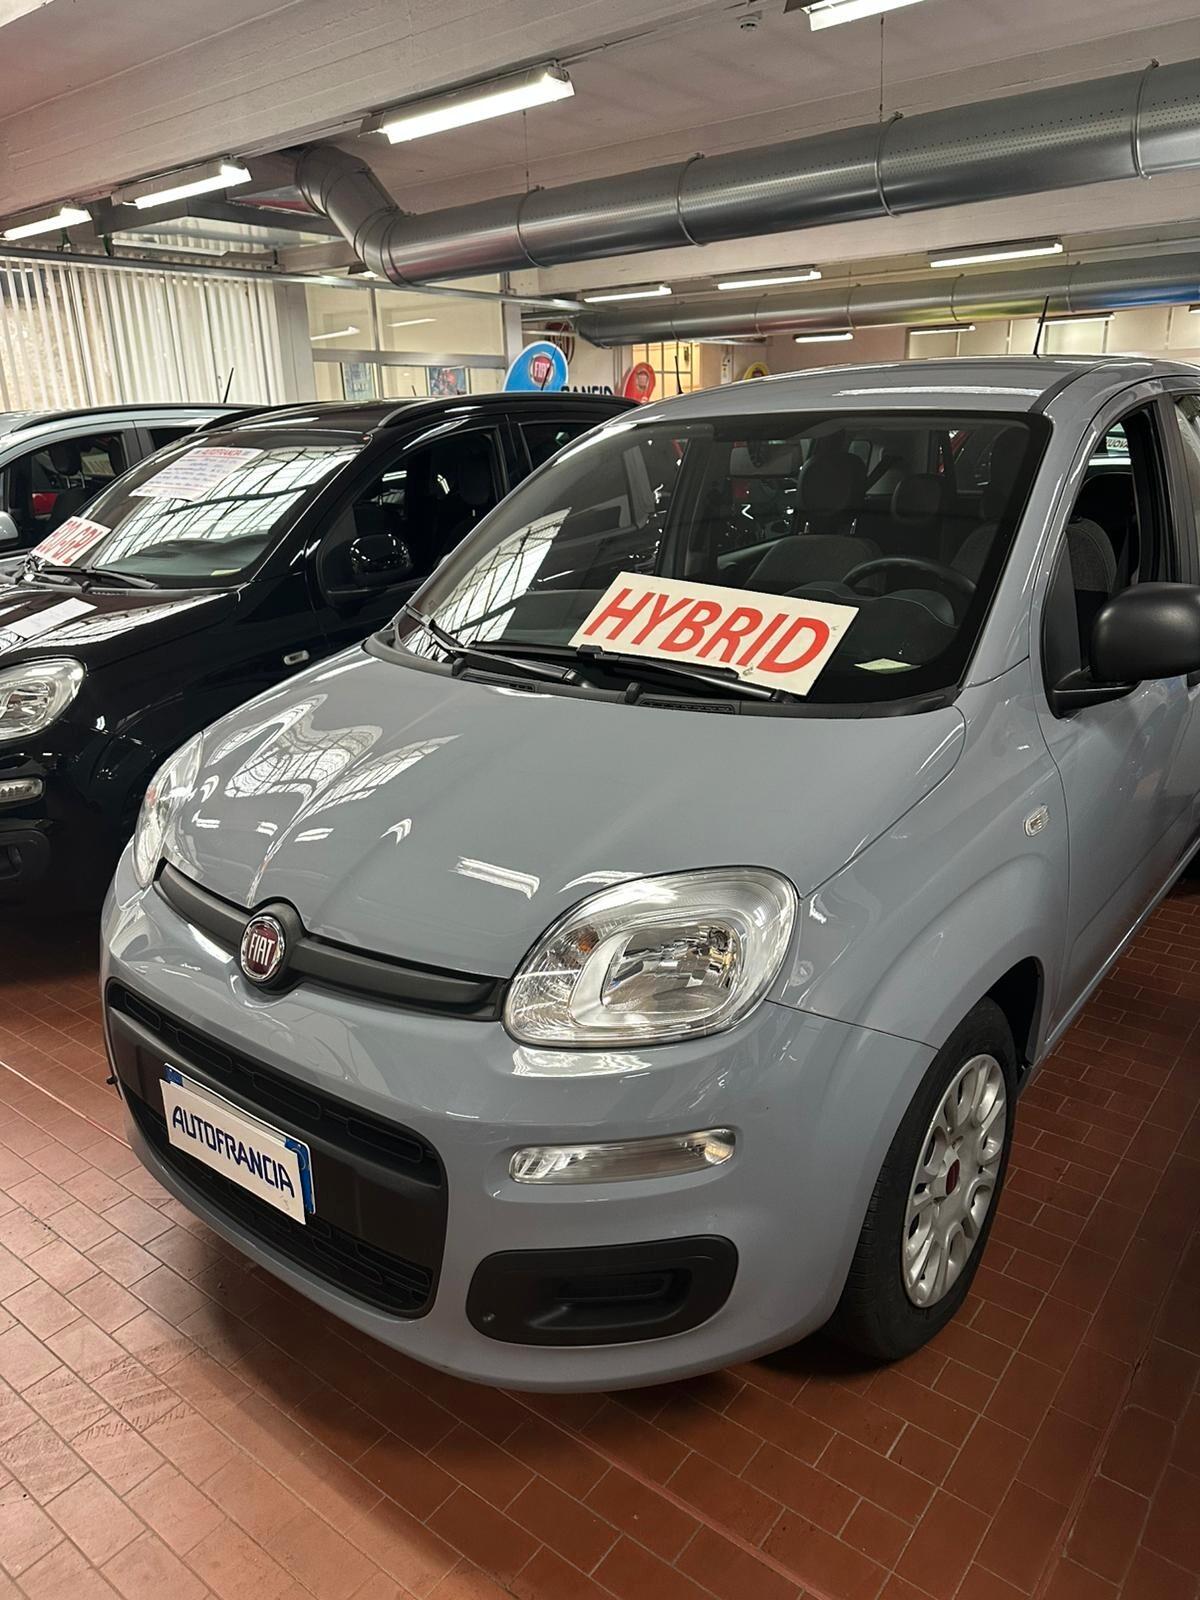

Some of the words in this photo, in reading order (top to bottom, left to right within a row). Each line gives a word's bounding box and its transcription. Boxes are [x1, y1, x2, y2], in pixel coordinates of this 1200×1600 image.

[583, 588, 830, 673] HYBRID
[248, 933, 275, 966] FIAT
[172, 1106, 295, 1198] AUTOFRANCIA
